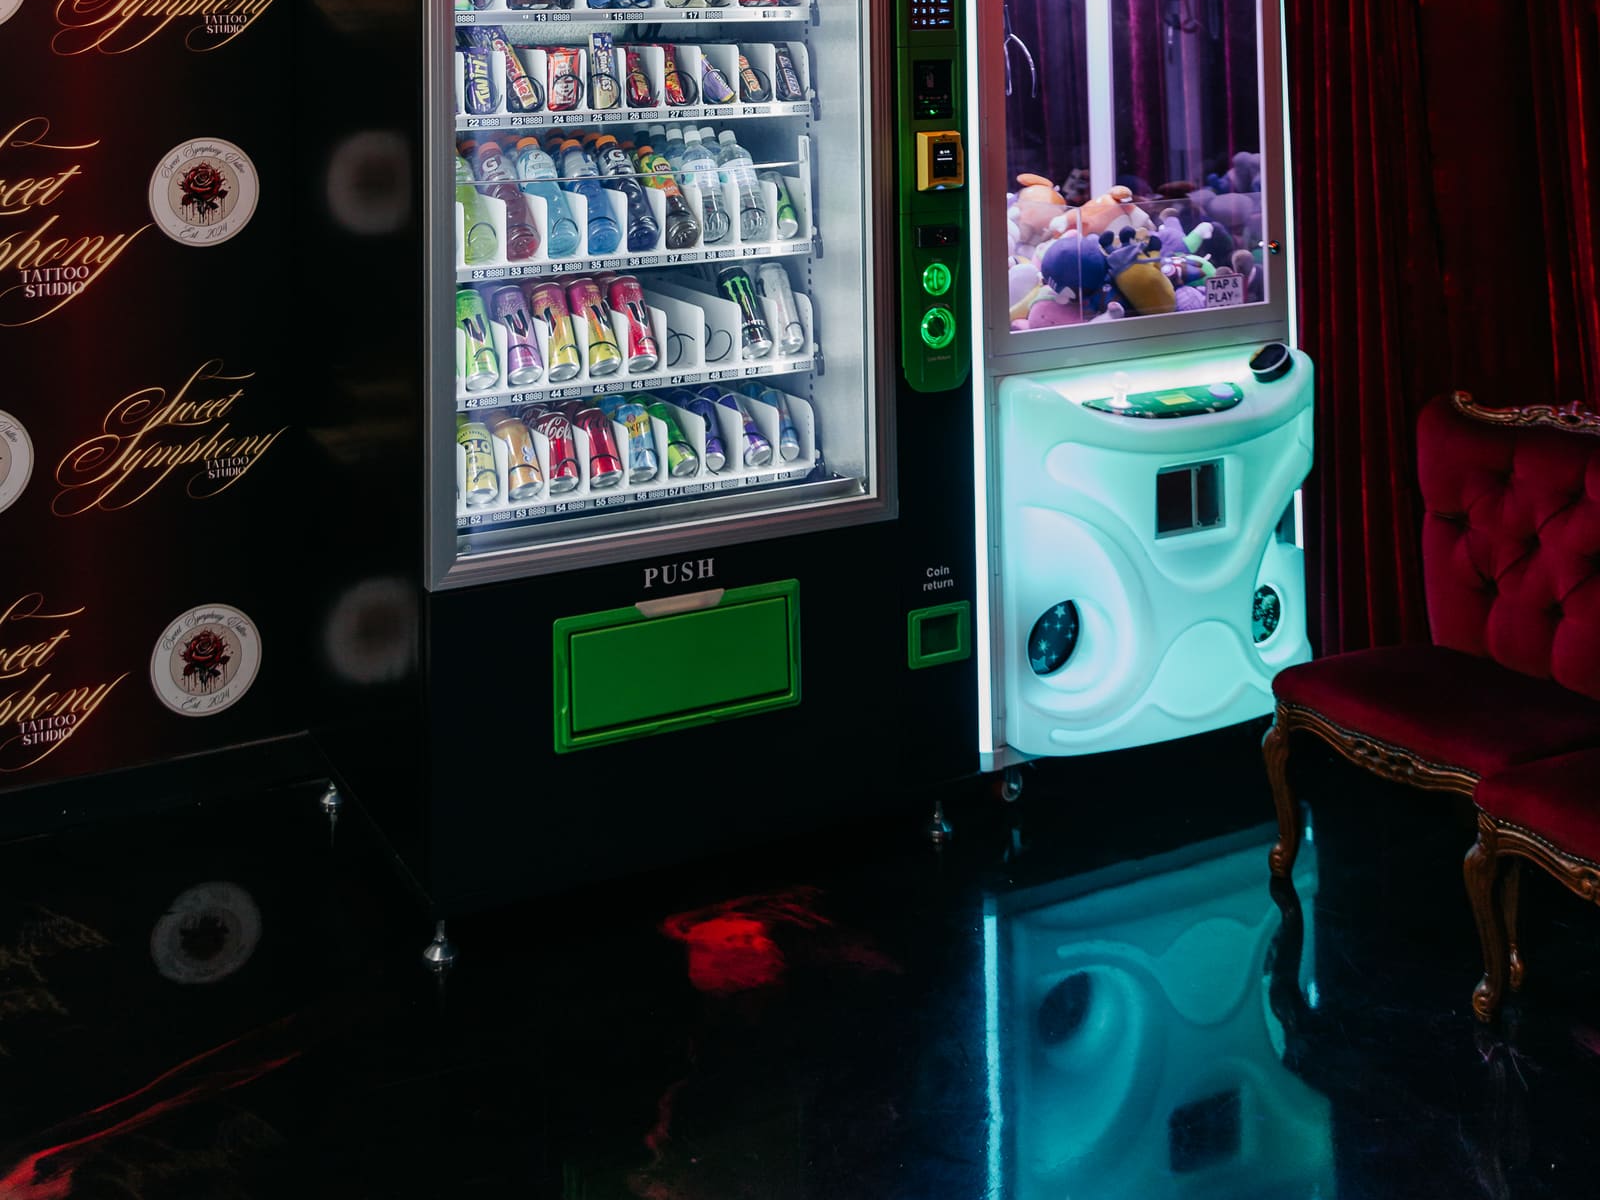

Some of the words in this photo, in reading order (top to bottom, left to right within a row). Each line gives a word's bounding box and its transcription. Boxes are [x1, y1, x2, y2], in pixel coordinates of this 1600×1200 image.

[203, 15, 248, 24] TATTOO
[206, 24, 245, 34] STUDIO
[468, 119, 480, 127] 22
[512, 117, 523, 125] 23
[591, 261, 602, 269] 35
[629, 258, 640, 266] 36
[20, 265, 90, 284] TATTOO
[473, 270, 485, 278] 32
[511, 267, 522, 275] 33
[24, 281, 85, 298] STUDIO
[1210, 279, 1230, 290] TAP
[1208, 291, 1235, 303] PLAY
[104, 358, 255, 438] Sweet
[205, 456, 249, 469] TATTOO
[208, 466, 247, 479] STUDIO
[556, 504, 566, 512] 54
[470, 516, 481, 524] 52
[643, 558, 715, 589] PUSH
[926, 565, 950, 578] Coin
[923, 579, 954, 592] return
[18, 714, 77, 734] TATTOO
[22, 727, 74, 746] STUDIO
